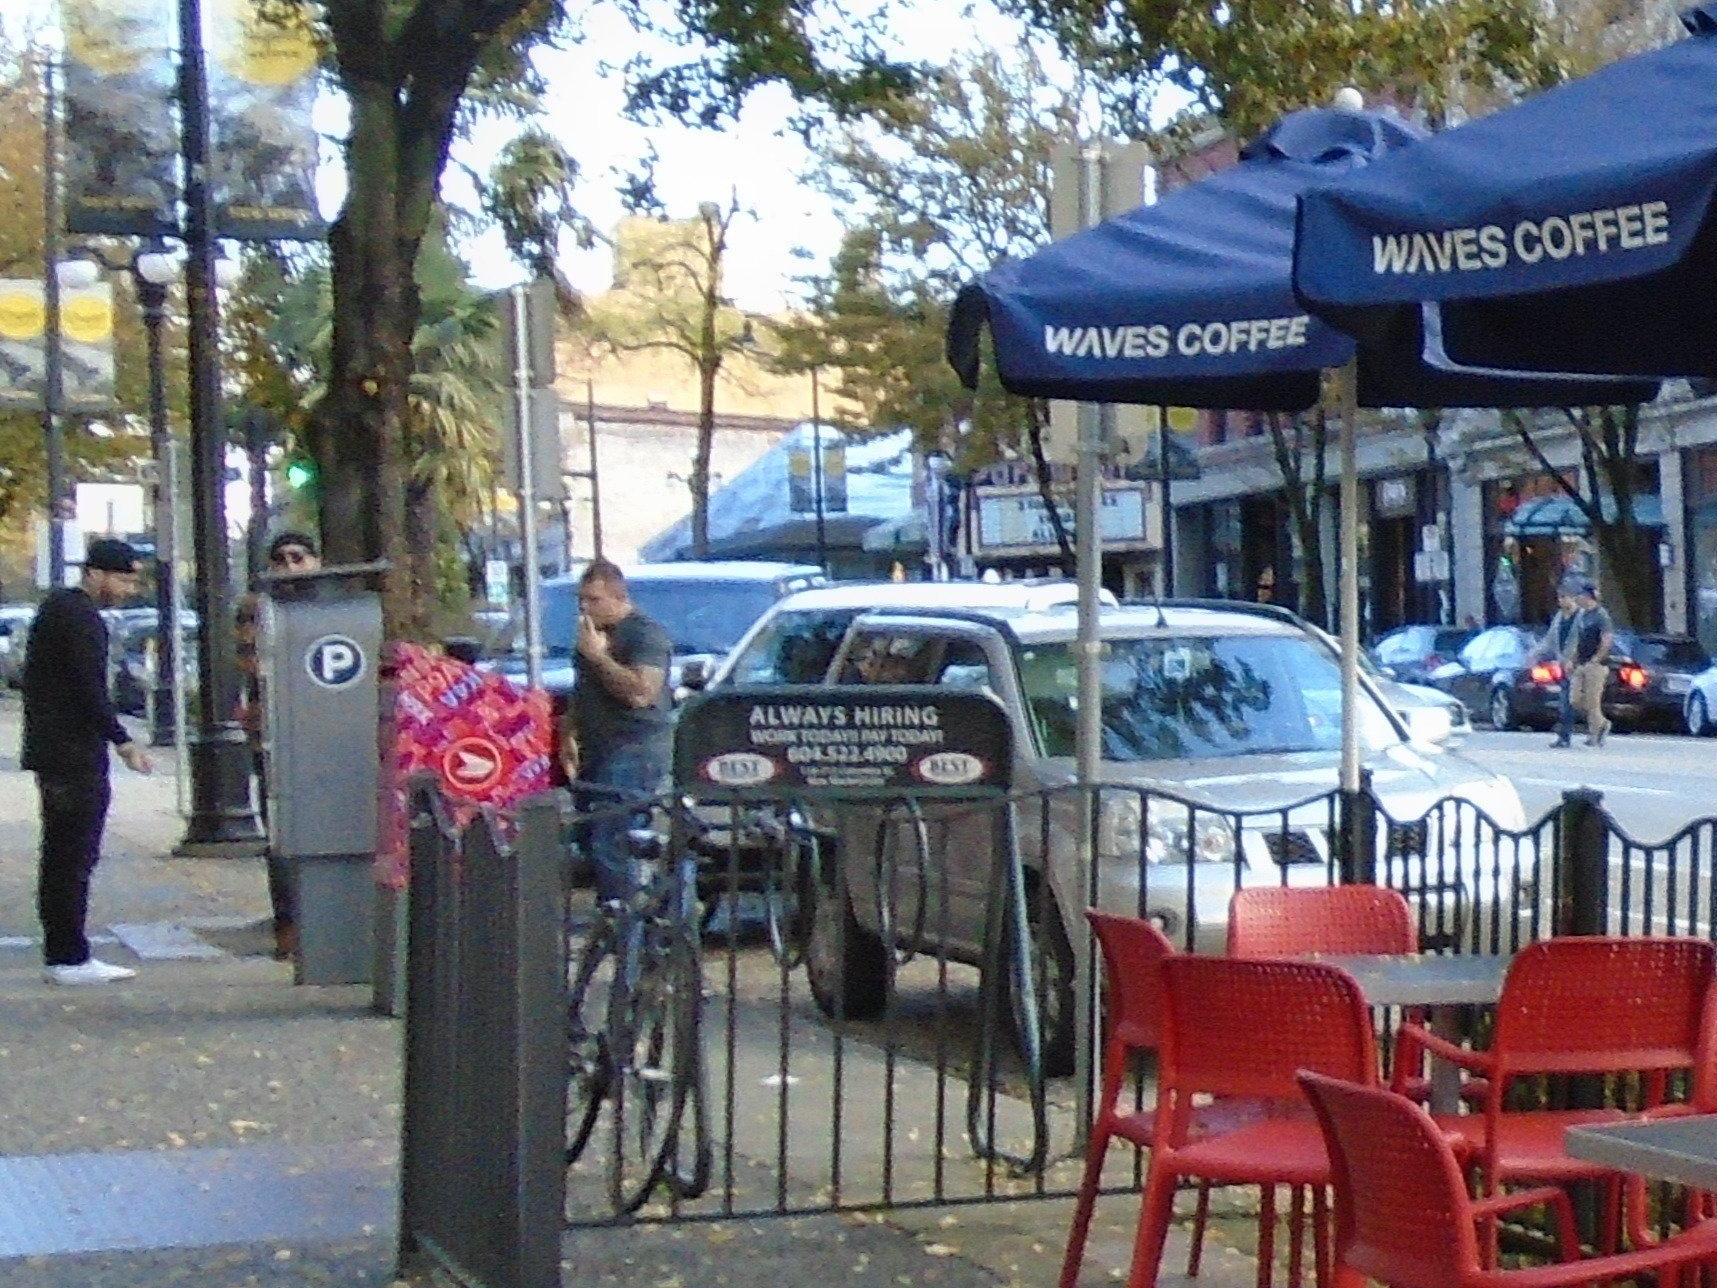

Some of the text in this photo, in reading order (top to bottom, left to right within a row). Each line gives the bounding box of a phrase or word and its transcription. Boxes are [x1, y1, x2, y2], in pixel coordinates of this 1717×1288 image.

[1372, 200, 1669, 274] WAVES COFFEE
[1043, 315, 1311, 358] WAVES COFFEE
[322, 646, 354, 681] P
[749, 705, 940, 726] ALWAYS HIRING
